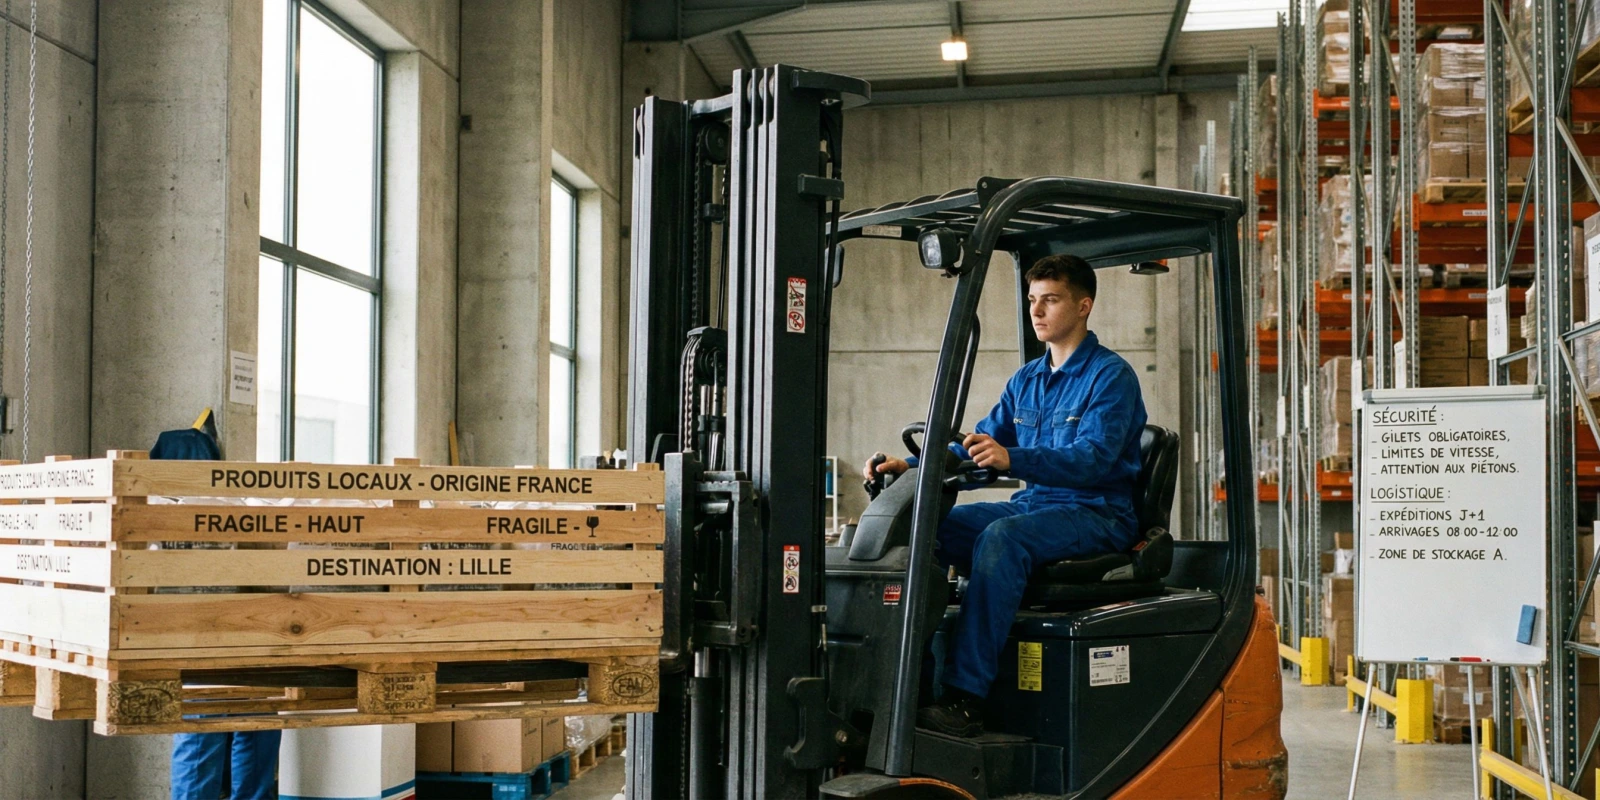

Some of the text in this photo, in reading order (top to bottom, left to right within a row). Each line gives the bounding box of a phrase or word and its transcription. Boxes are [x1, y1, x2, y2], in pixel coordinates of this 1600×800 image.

[1372, 405, 1437, 425] SÉCURITÉ
[1381, 430, 1421, 443] GILETS
[1428, 428, 1510, 443] OBLIGATOIRES,
[1381, 446, 1424, 459] LIMITES
[1431, 448, 1444, 458] DE
[1450, 446, 1499, 460] VITESSE,
[1381, 462, 1440, 475] ATTENTION
[1445, 463, 1465, 474] AUX
[1471, 460, 1520, 474] PIÉTONS.
[212, 470, 320, 490] PRODUITS
[328, 472, 413, 491] LOCAUX
[430, 473, 511, 492] ORIGINE
[517, 475, 592, 494] FRANCE
[1370, 484, 1445, 499] LOGISTIQUE
[1380, 507, 1452, 522] EXPÉDITIONS
[1459, 509, 1486, 521] J+1
[194, 514, 288, 533] FRAGILE
[308, 515, 365, 534] HAUT
[487, 516, 568, 535] FRAGILE
[1379, 524, 1440, 537] ARRIVAGES
[1378, 549, 1407, 560] ZONE
[1412, 549, 1426, 560] DE
[1431, 549, 1486, 561] STOCKAGE
[1493, 548, 1508, 562] A.
[307, 558, 440, 577] DESTINATION
[460, 559, 512, 576] LILLE
